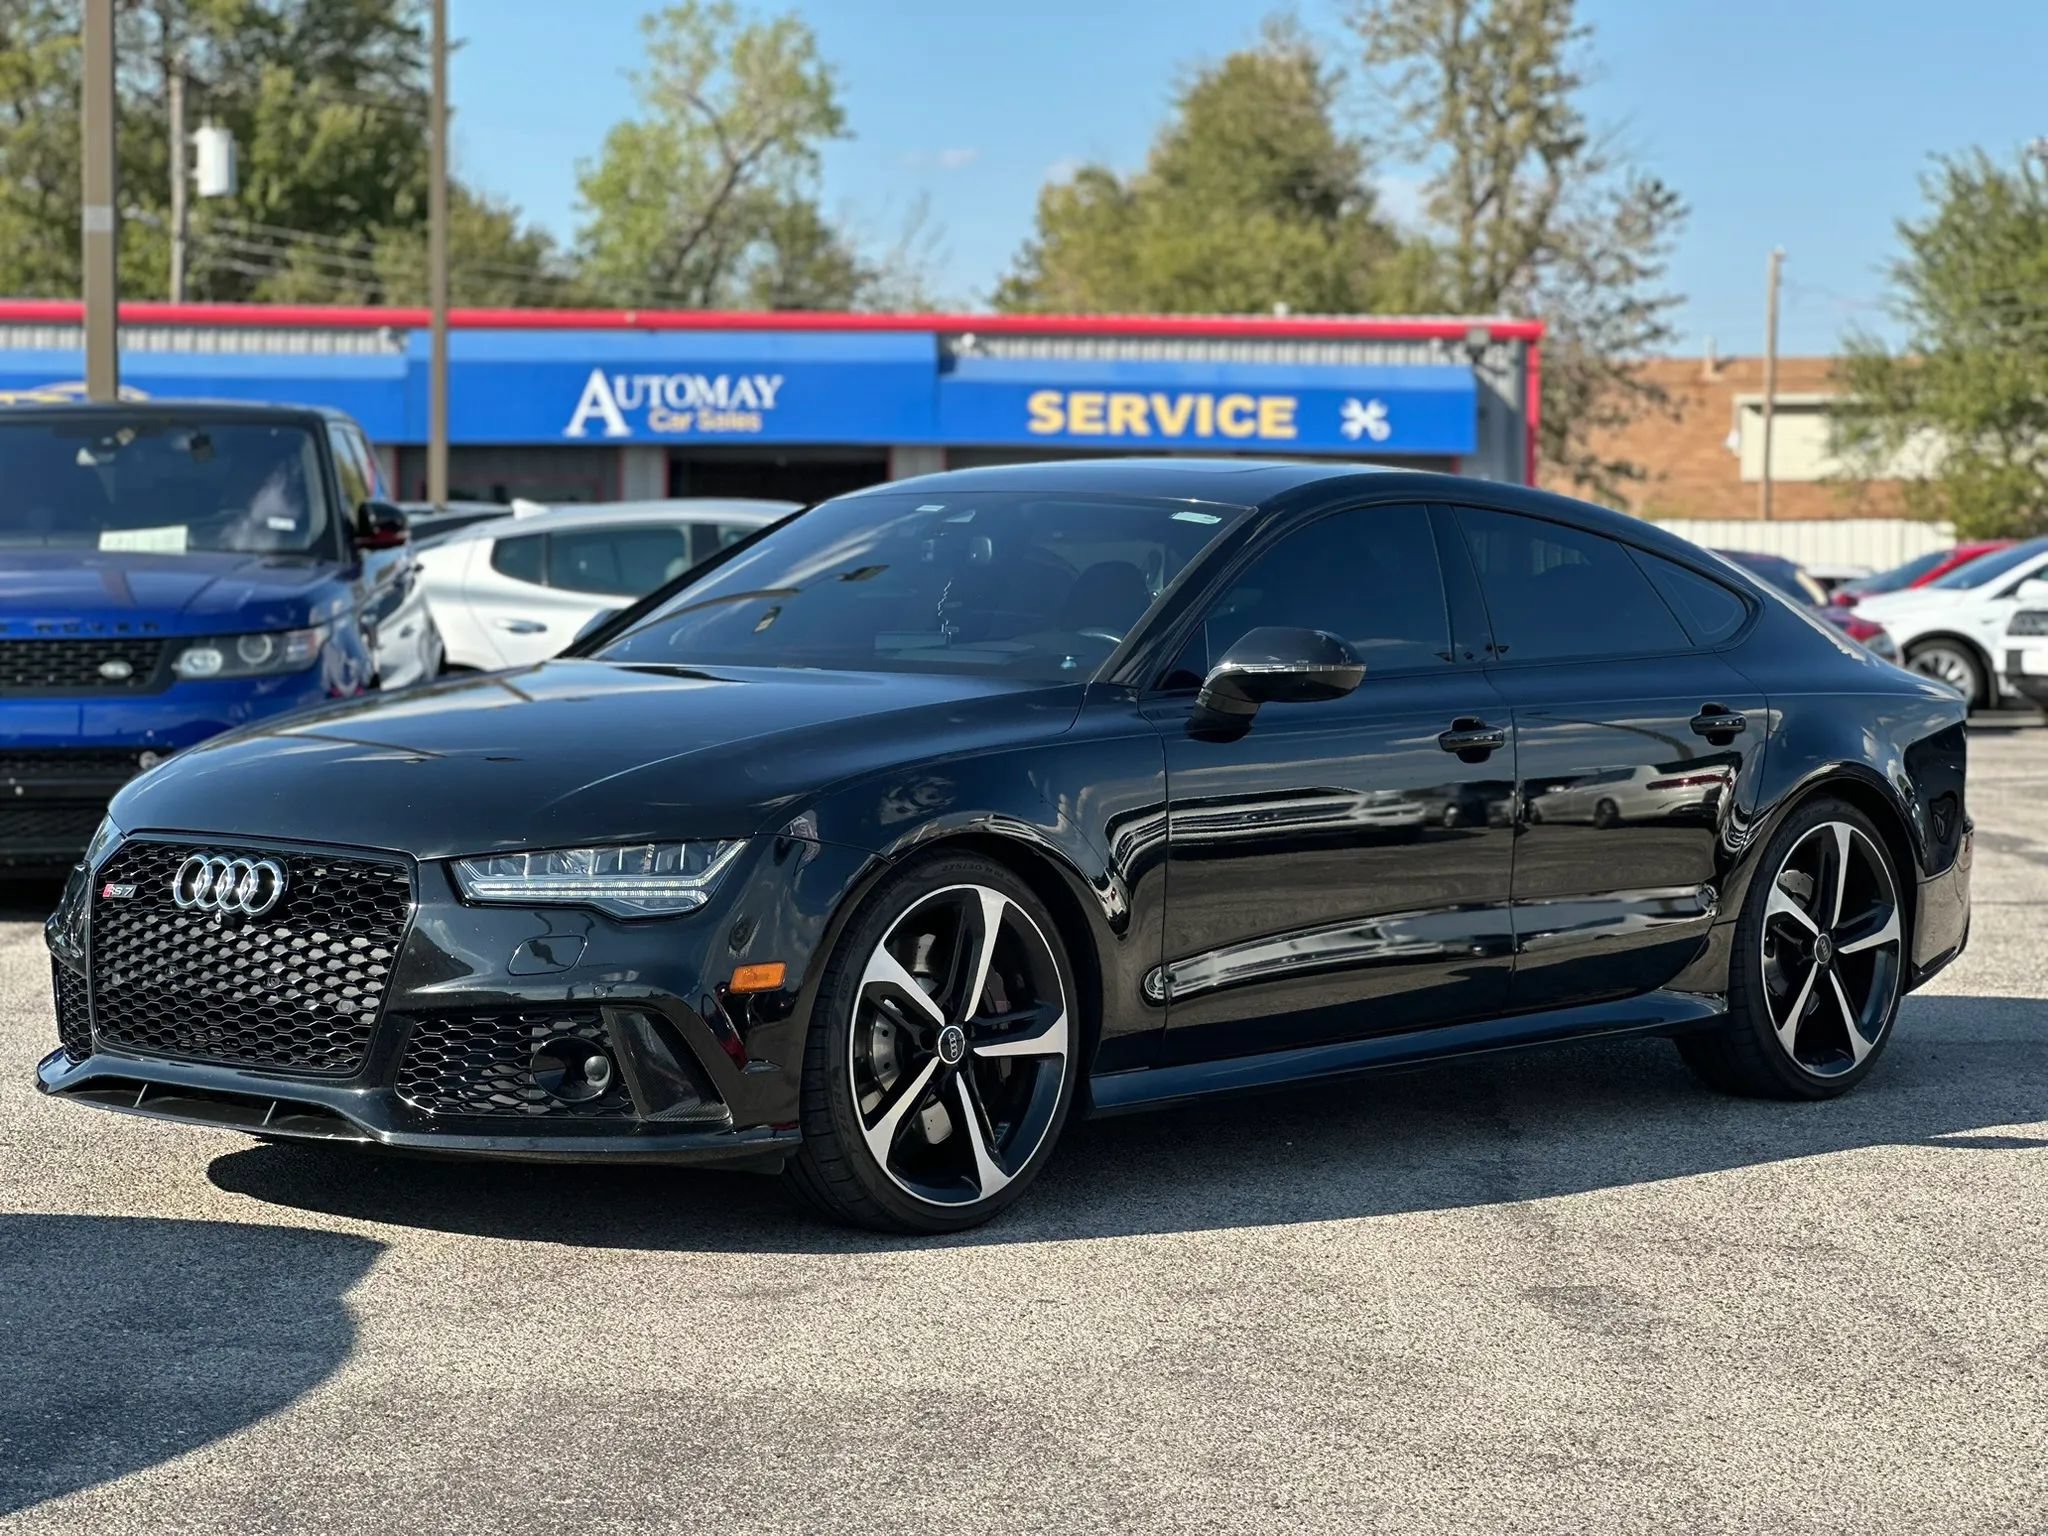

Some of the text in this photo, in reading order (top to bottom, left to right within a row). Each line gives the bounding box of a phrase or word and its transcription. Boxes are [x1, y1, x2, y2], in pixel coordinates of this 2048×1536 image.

[563, 368, 784, 437] AUTOMAY
[648, 407, 762, 432] Car Sales
[1027, 390, 1298, 438] SERVICE
